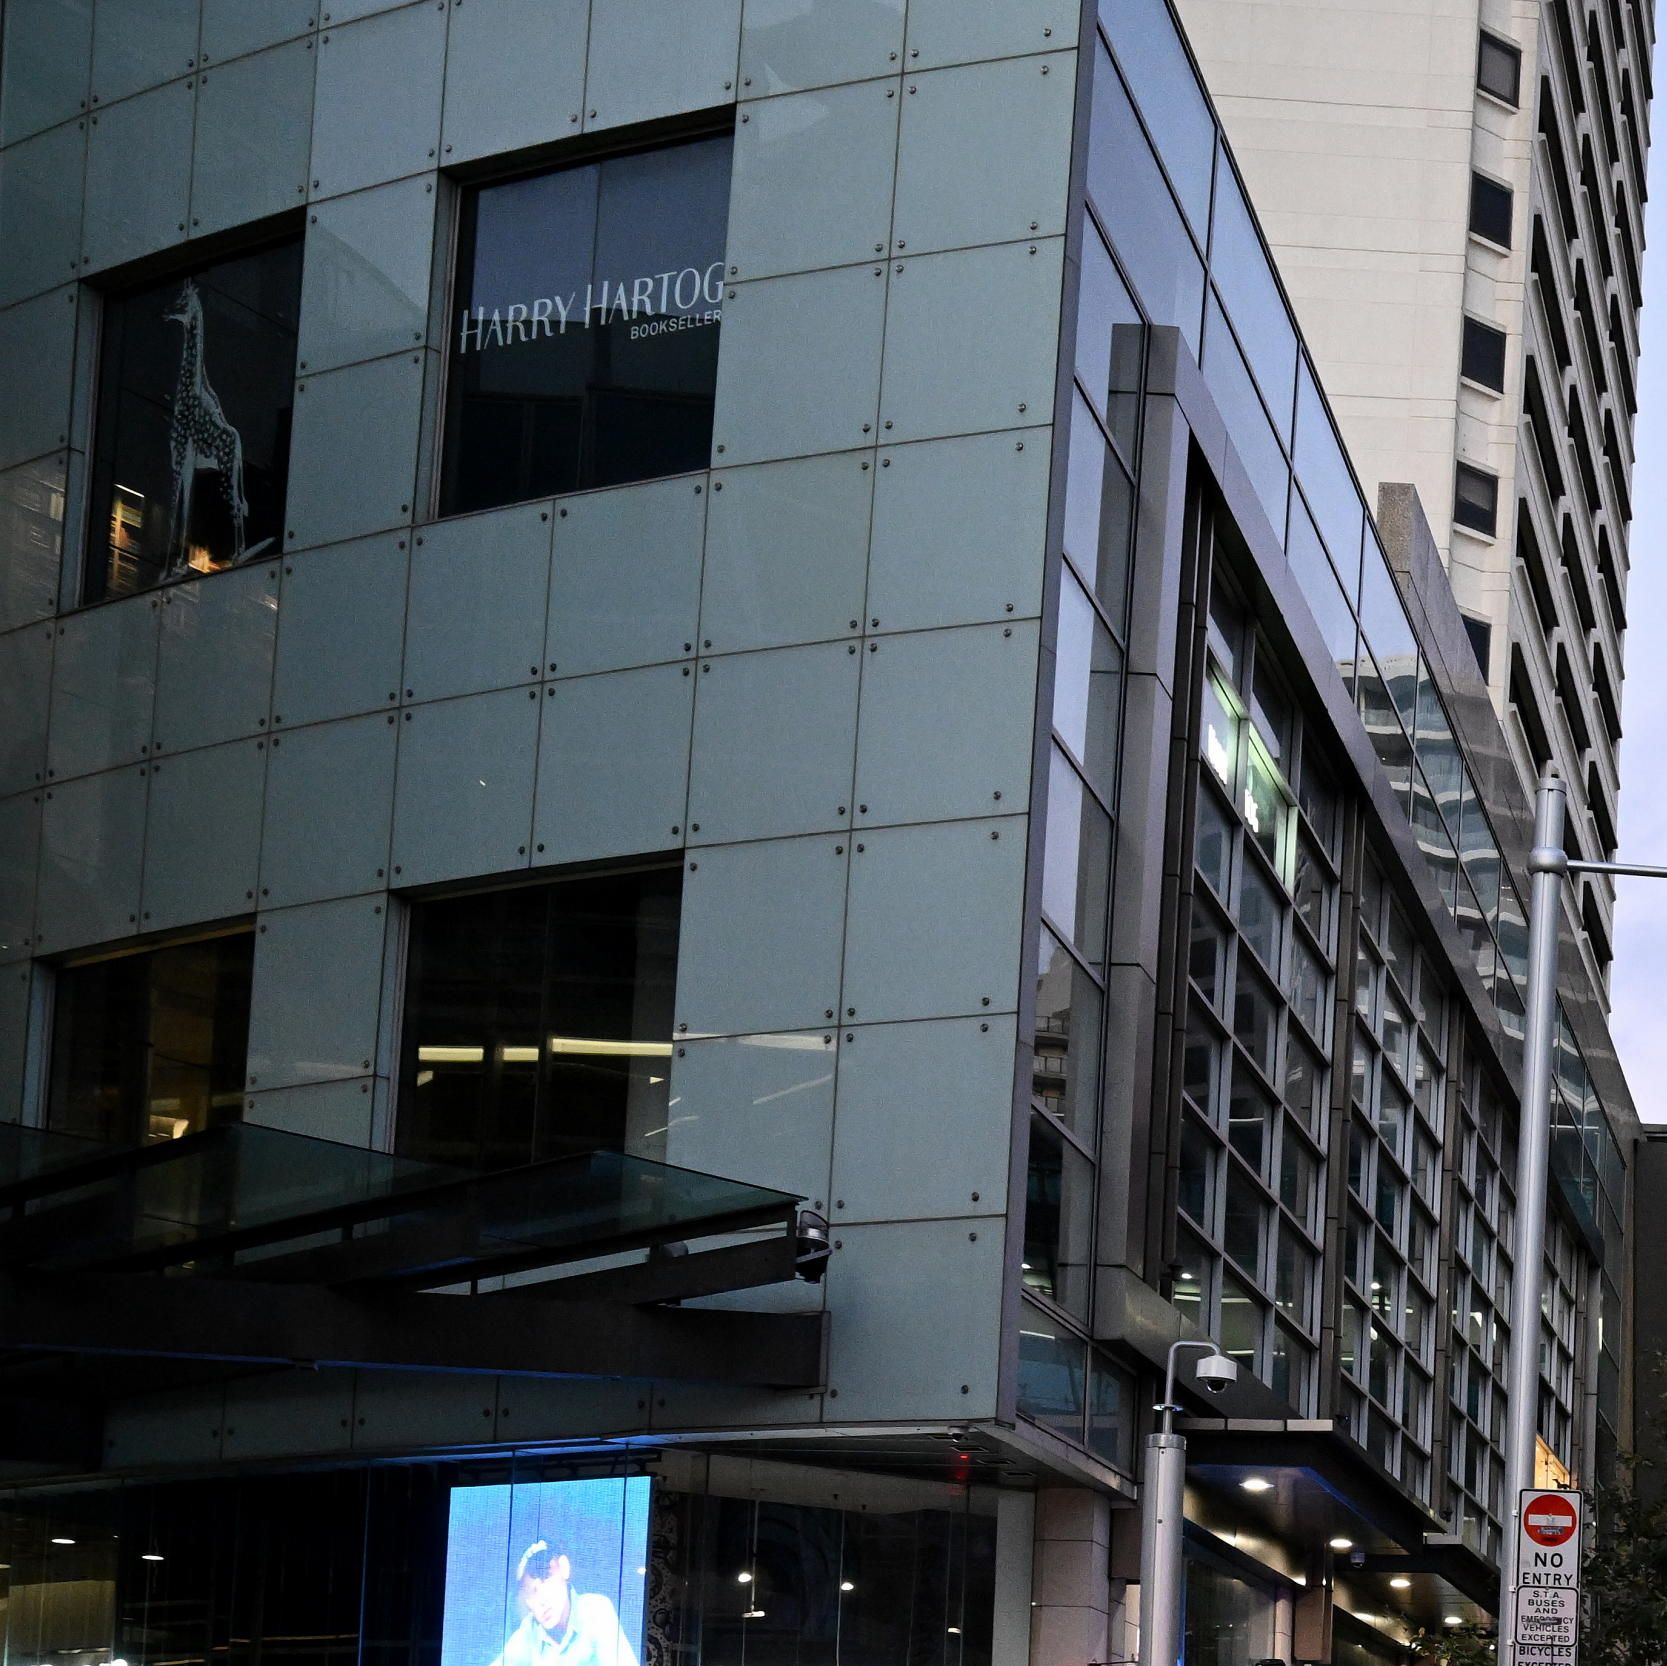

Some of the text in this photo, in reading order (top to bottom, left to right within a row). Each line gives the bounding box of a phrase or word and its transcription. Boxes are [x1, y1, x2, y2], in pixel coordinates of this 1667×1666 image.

[460, 262, 725, 354] HARRY HARTOG
[1534, 1552, 1564, 1569] NO
[1522, 1572, 1573, 1586] ENTRY
[1528, 1599, 1565, 1608] BUSES
[1534, 1607, 1558, 1615] AND
[1523, 1624, 1569, 1633] VEHICLES
[1521, 1633, 1570, 1643] EXCEPTED
[1519, 1646, 1572, 1657] BICYCLES
